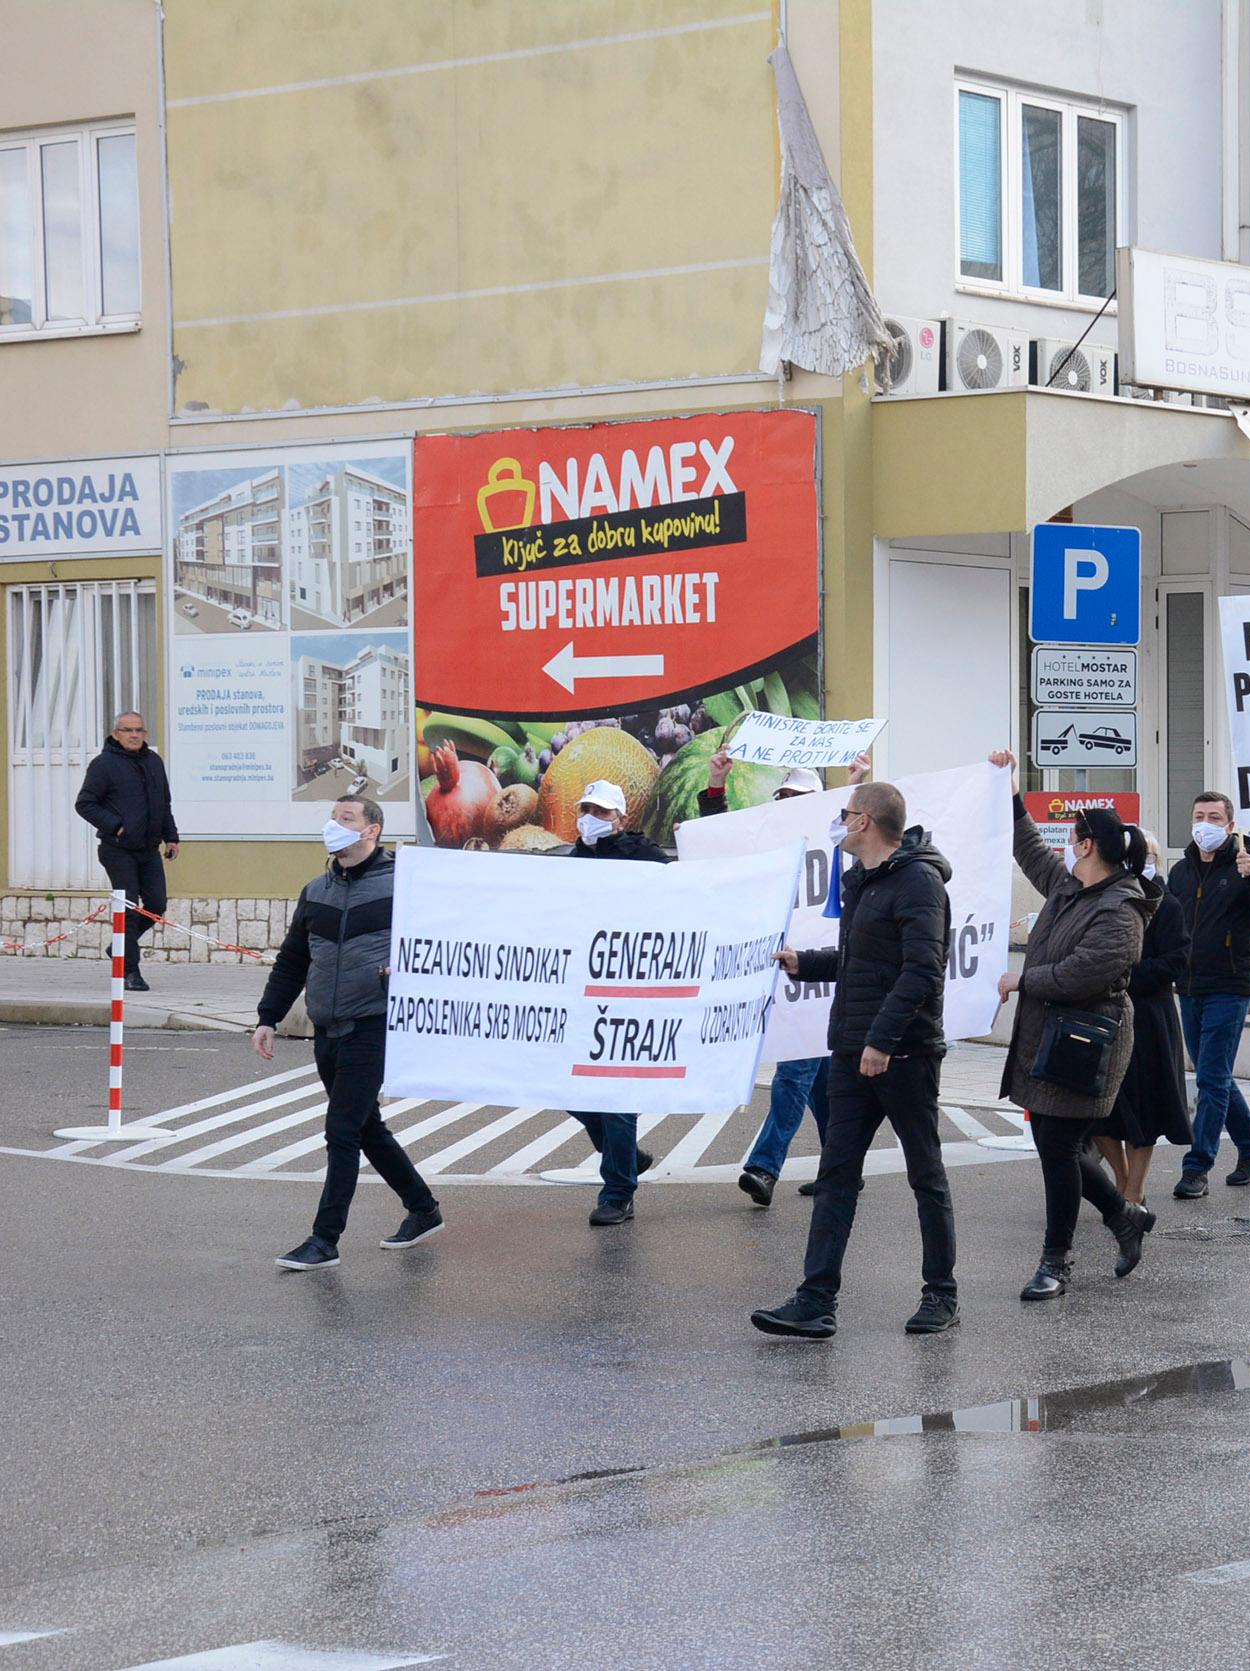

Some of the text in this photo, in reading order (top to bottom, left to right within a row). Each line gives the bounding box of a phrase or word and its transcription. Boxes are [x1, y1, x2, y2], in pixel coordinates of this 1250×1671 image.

[1013, 345, 1021, 372] VOX
[1099, 359, 1107, 386] VOX
[538, 436, 739, 525] NAMEX
[553, 534, 582, 557] za
[587, 520, 636, 552] dobru
[641, 500, 721, 548] kupovinu!
[1063, 548, 1110, 620] P
[499, 571, 720, 631] SUPERMARKET
[1040, 677, 1131, 688] PARKING SAMO ZA
[196, 689, 265, 701] PRODAJA stanova,
[1047, 691, 1123, 700] GOSTE HOTELA
[178, 705, 209, 716] uredskih
[215, 703, 251, 716] poslovnih
[252, 703, 285, 715] prostora
[748, 712, 811, 734] MINISTRE
[855, 722, 874, 733] SE
[789, 736, 834, 747] ZA NAS
[730, 743, 747, 758] A
[752, 747, 774, 761] NE
[778, 750, 838, 765] PROTIV
[1065, 798, 1115, 811] NAMEX
[1038, 825, 1068, 835] splatan
[397, 937, 492, 980] NEZAVISNI
[494, 944, 572, 985] SINDIKAT
[588, 930, 708, 980] GENERALNI
[388, 995, 481, 1038] ZAPOSLENIKA
[484, 1003, 510, 1040] SKB
[512, 1005, 568, 1044] MOSTAR
[590, 1004, 683, 1062] ŠTRAJK
